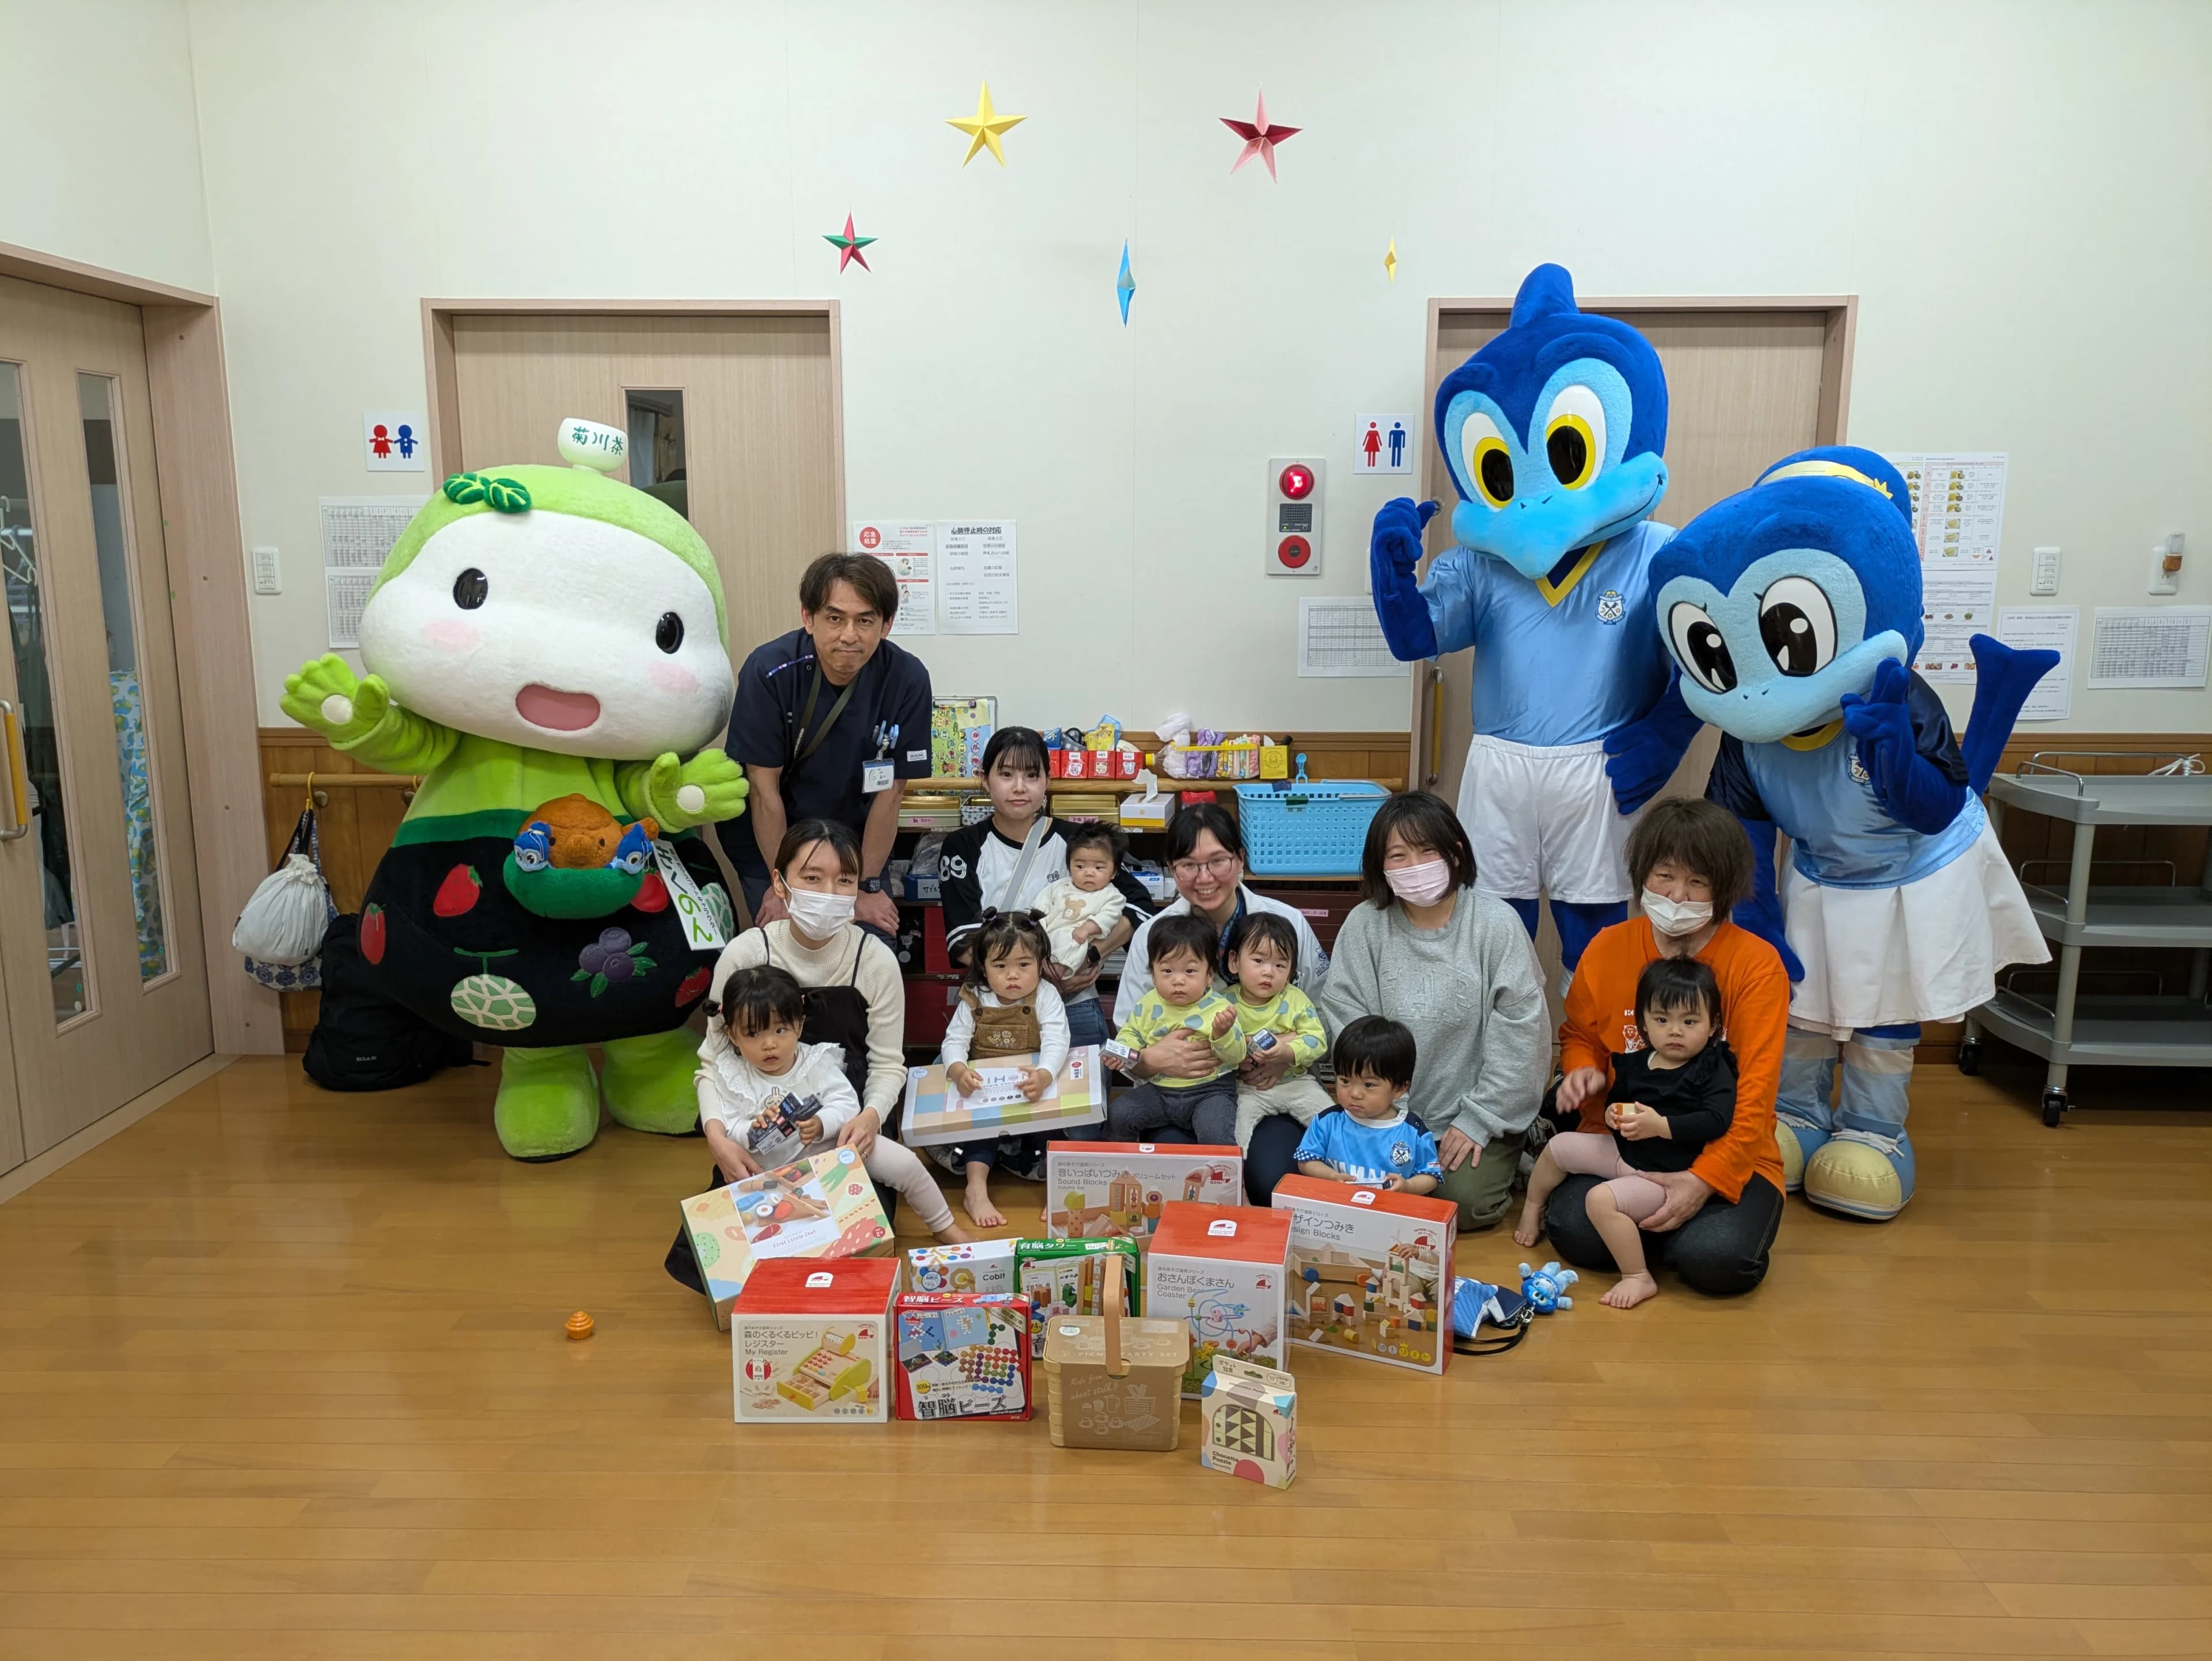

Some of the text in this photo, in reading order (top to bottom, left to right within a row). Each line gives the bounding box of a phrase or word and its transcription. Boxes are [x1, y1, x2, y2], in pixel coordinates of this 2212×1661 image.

[572, 426, 624, 456] 菊川茶
[1327, 1158, 1402, 1181] YAMA
[1294, 1214, 1355, 1234] ザインつみき
[1291, 1227, 1340, 1240] esign Blocks
[983, 1273, 1005, 1281] Cobit
[1157, 1284, 1185, 1292] Garden
[1157, 1291, 1186, 1299] Coaster
[1212, 1451, 1239, 1462] Chocotto
[1213, 1456, 1232, 1466] Puzzle
